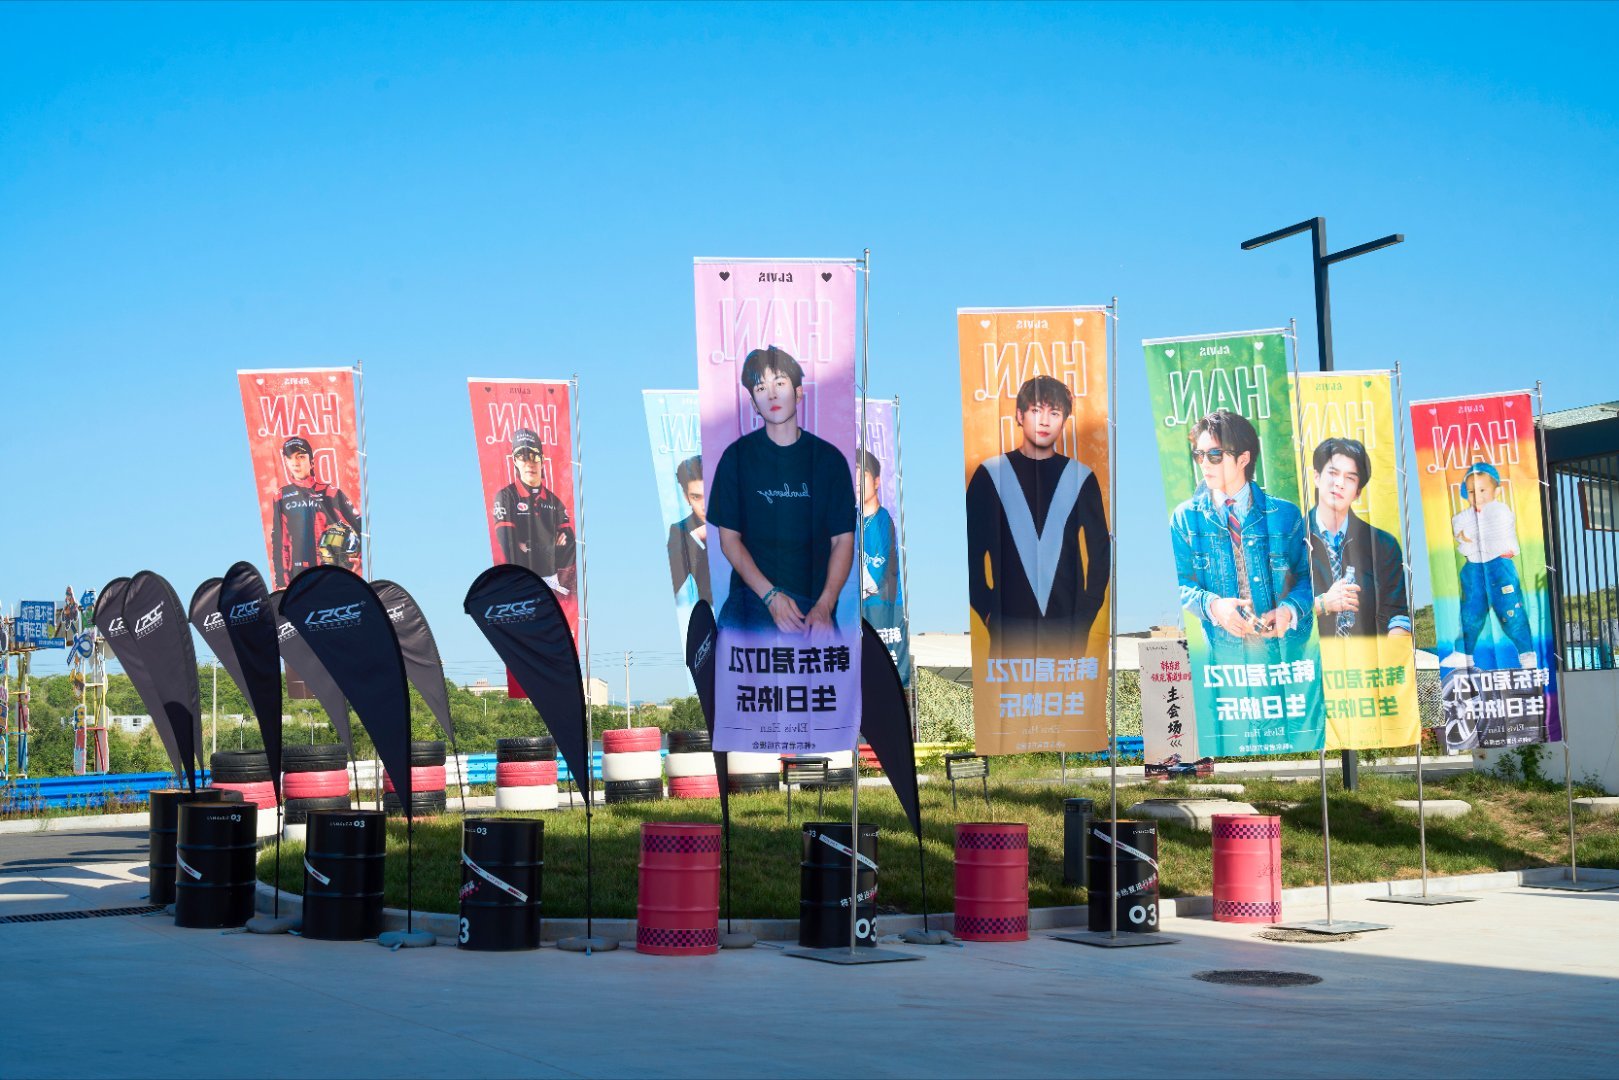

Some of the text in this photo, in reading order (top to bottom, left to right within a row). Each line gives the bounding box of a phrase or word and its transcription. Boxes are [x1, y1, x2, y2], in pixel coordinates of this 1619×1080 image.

[1166, 686, 1182, 735] 主会场
[476, 827, 488, 836] 03
[1129, 904, 1157, 926] 03
[855, 917, 877, 942] 03
